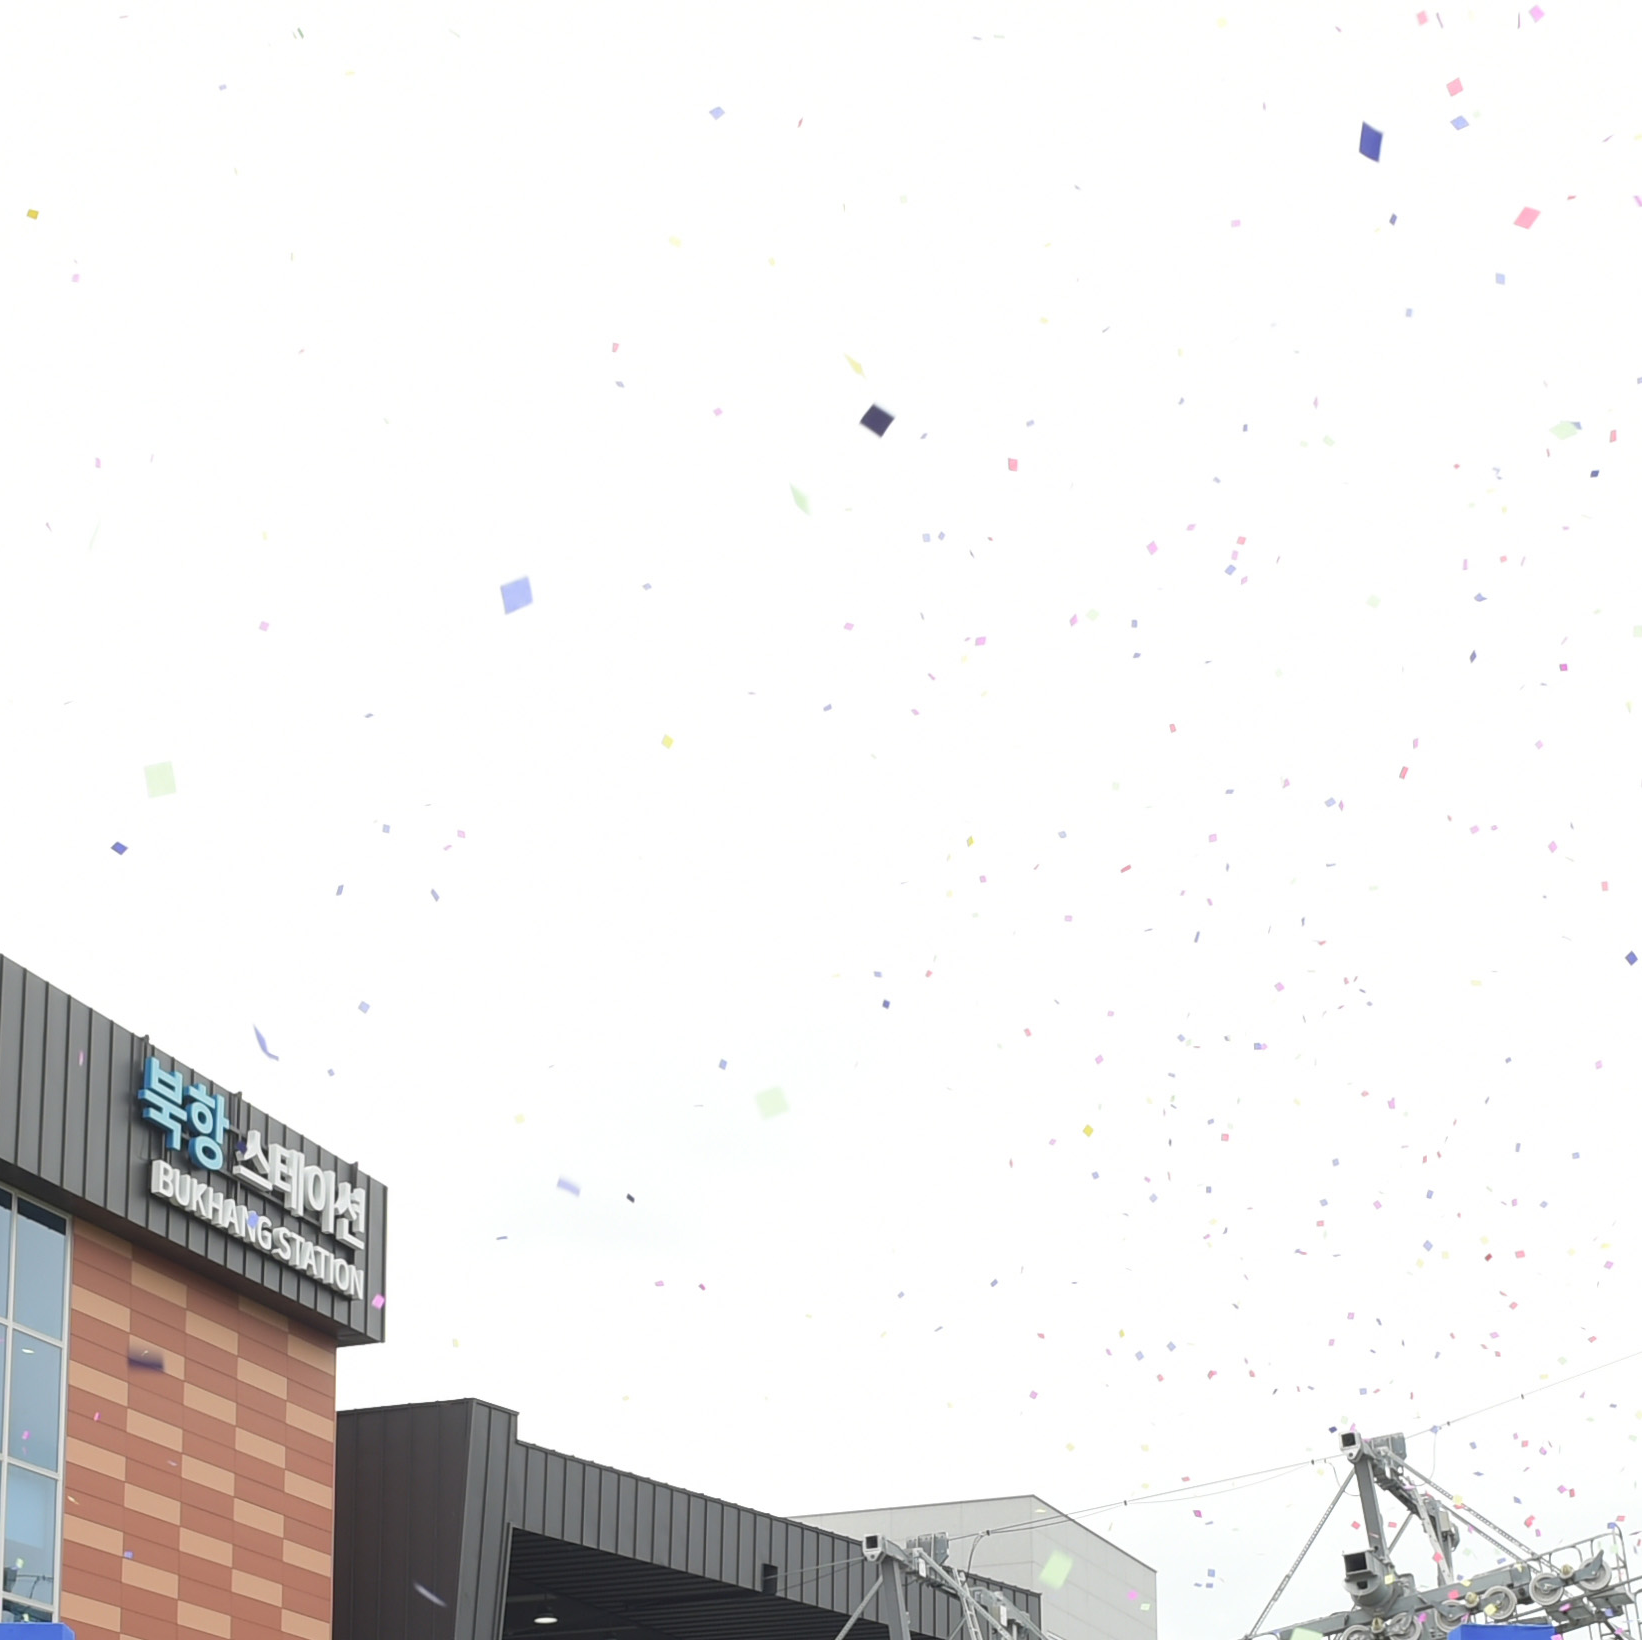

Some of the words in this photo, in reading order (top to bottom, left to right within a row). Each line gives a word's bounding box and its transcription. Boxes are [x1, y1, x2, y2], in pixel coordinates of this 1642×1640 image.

[138, 1057, 230, 1171] 북항
[233, 1130, 366, 1251] 스테이션
[151, 1159, 273, 1252] BUKHANG
[271, 1226, 364, 1301] STATION
